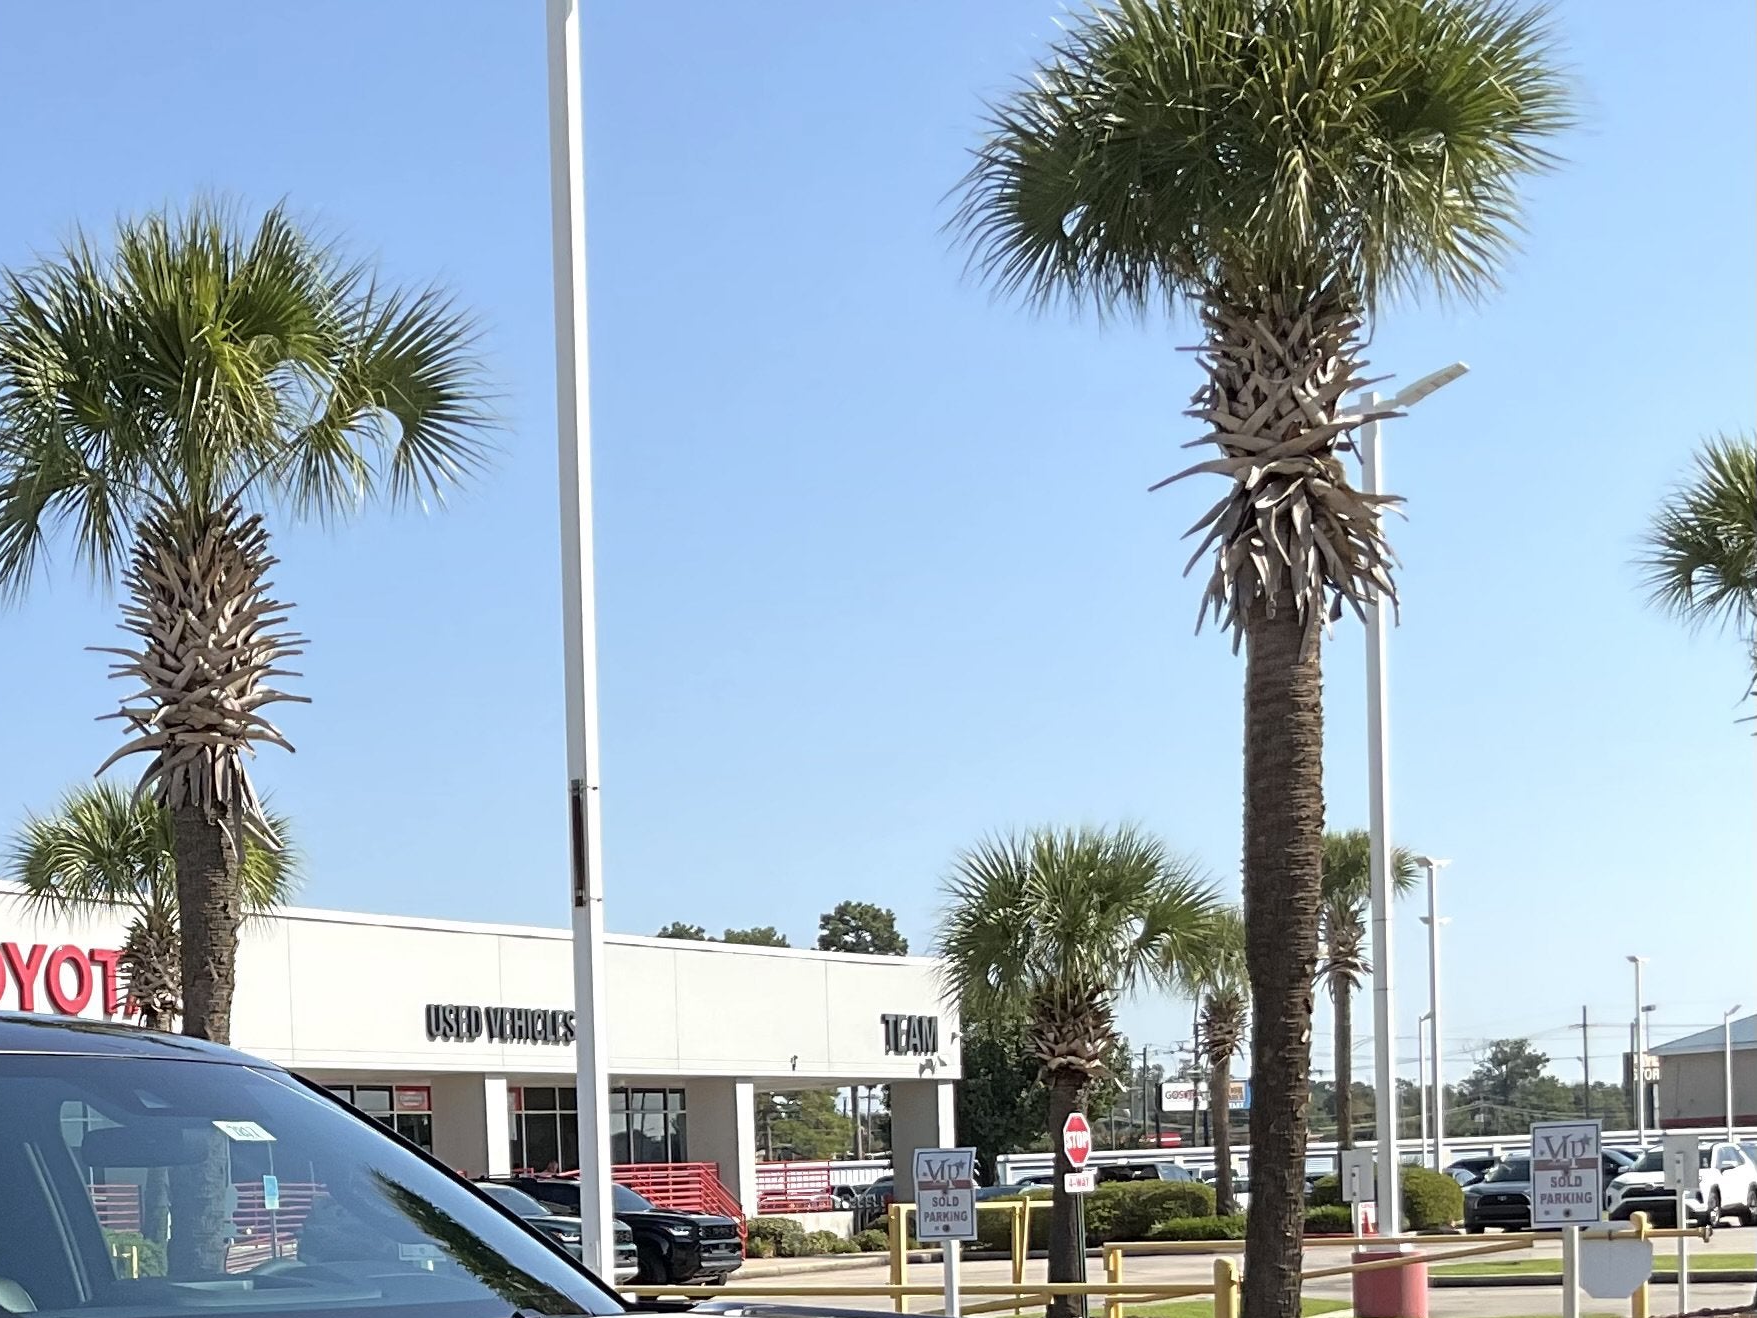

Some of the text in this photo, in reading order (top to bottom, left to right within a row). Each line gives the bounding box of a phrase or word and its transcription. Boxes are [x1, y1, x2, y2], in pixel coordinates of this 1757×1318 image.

[425, 1004, 576, 1046] USED VEHICLES
[880, 1013, 939, 1056] TEAM
[1066, 1131, 1089, 1149] STOP
[1541, 1133, 1586, 1168] VIP
[924, 1159, 961, 1189] VIP
[1550, 1176, 1582, 1188] SOLD
[932, 1196, 959, 1207] SOLD
[1540, 1192, 1593, 1205] PARKING
[924, 1211, 968, 1222] PARKING
